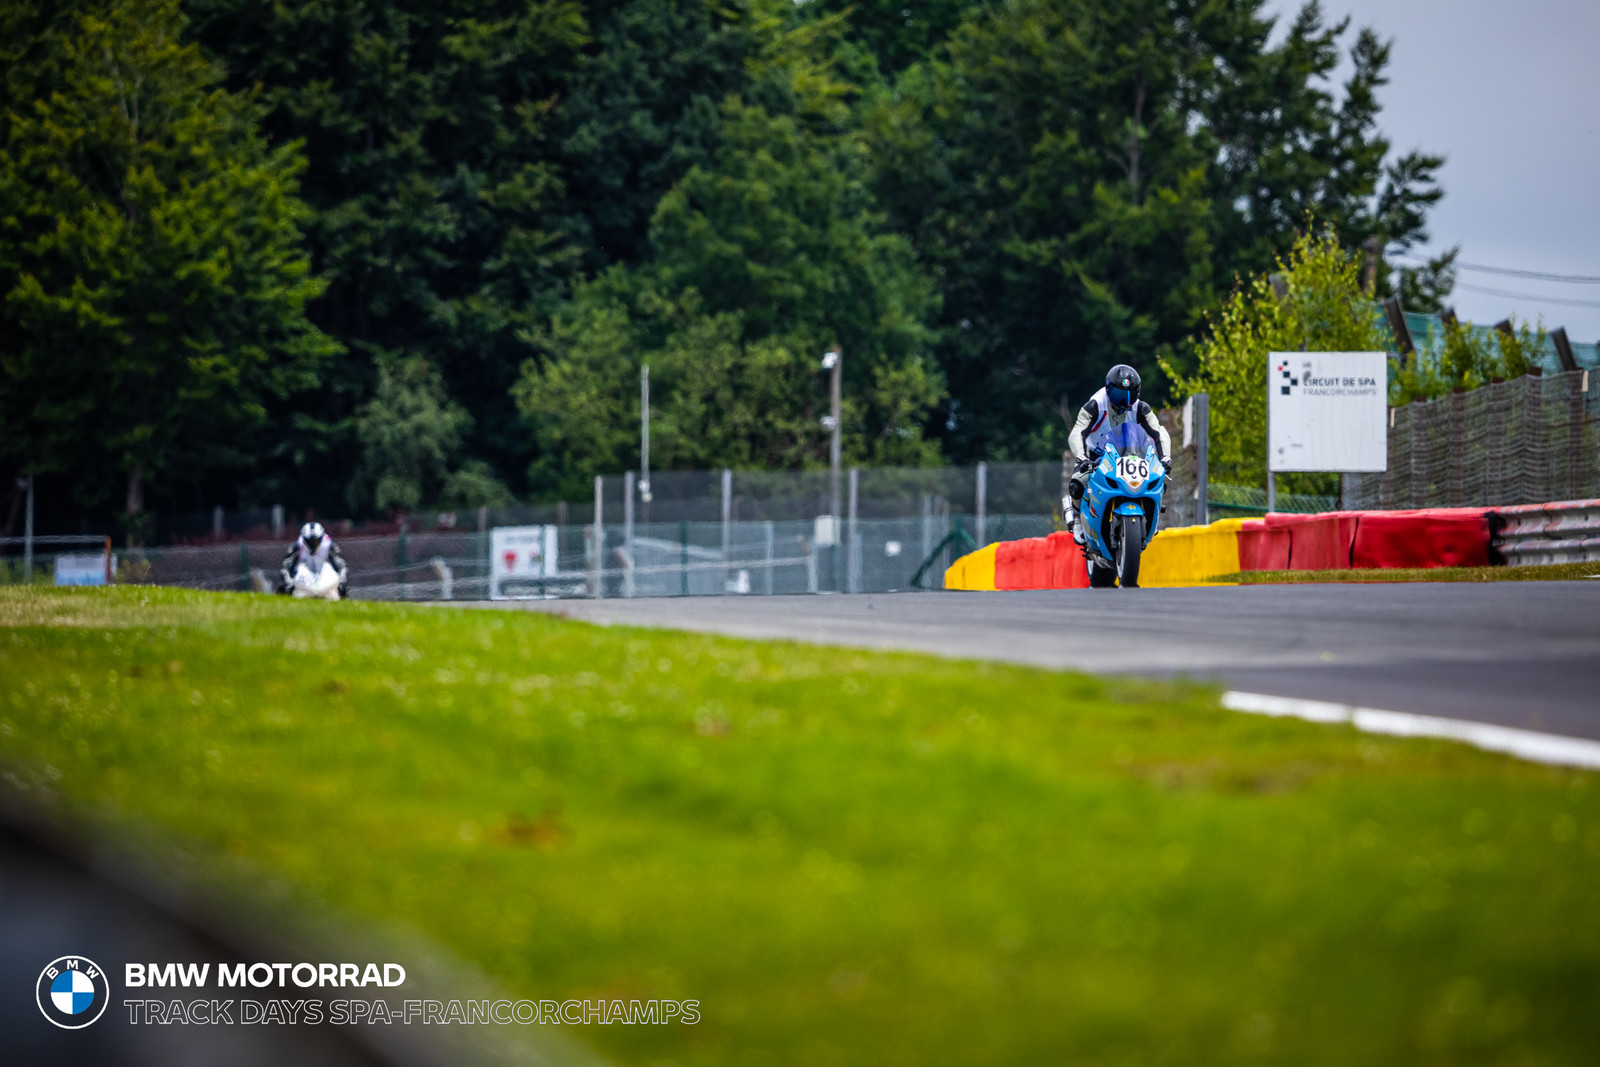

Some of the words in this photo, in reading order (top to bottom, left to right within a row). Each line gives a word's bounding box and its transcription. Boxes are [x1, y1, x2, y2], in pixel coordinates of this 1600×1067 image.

[1303, 377, 1339, 387] CIRCUIT
[1343, 377, 1356, 387] DE
[1358, 377, 1377, 387] SPA
[1303, 387, 1377, 397] FRANCORCHAMPS
[1117, 458, 1149, 478] 166
